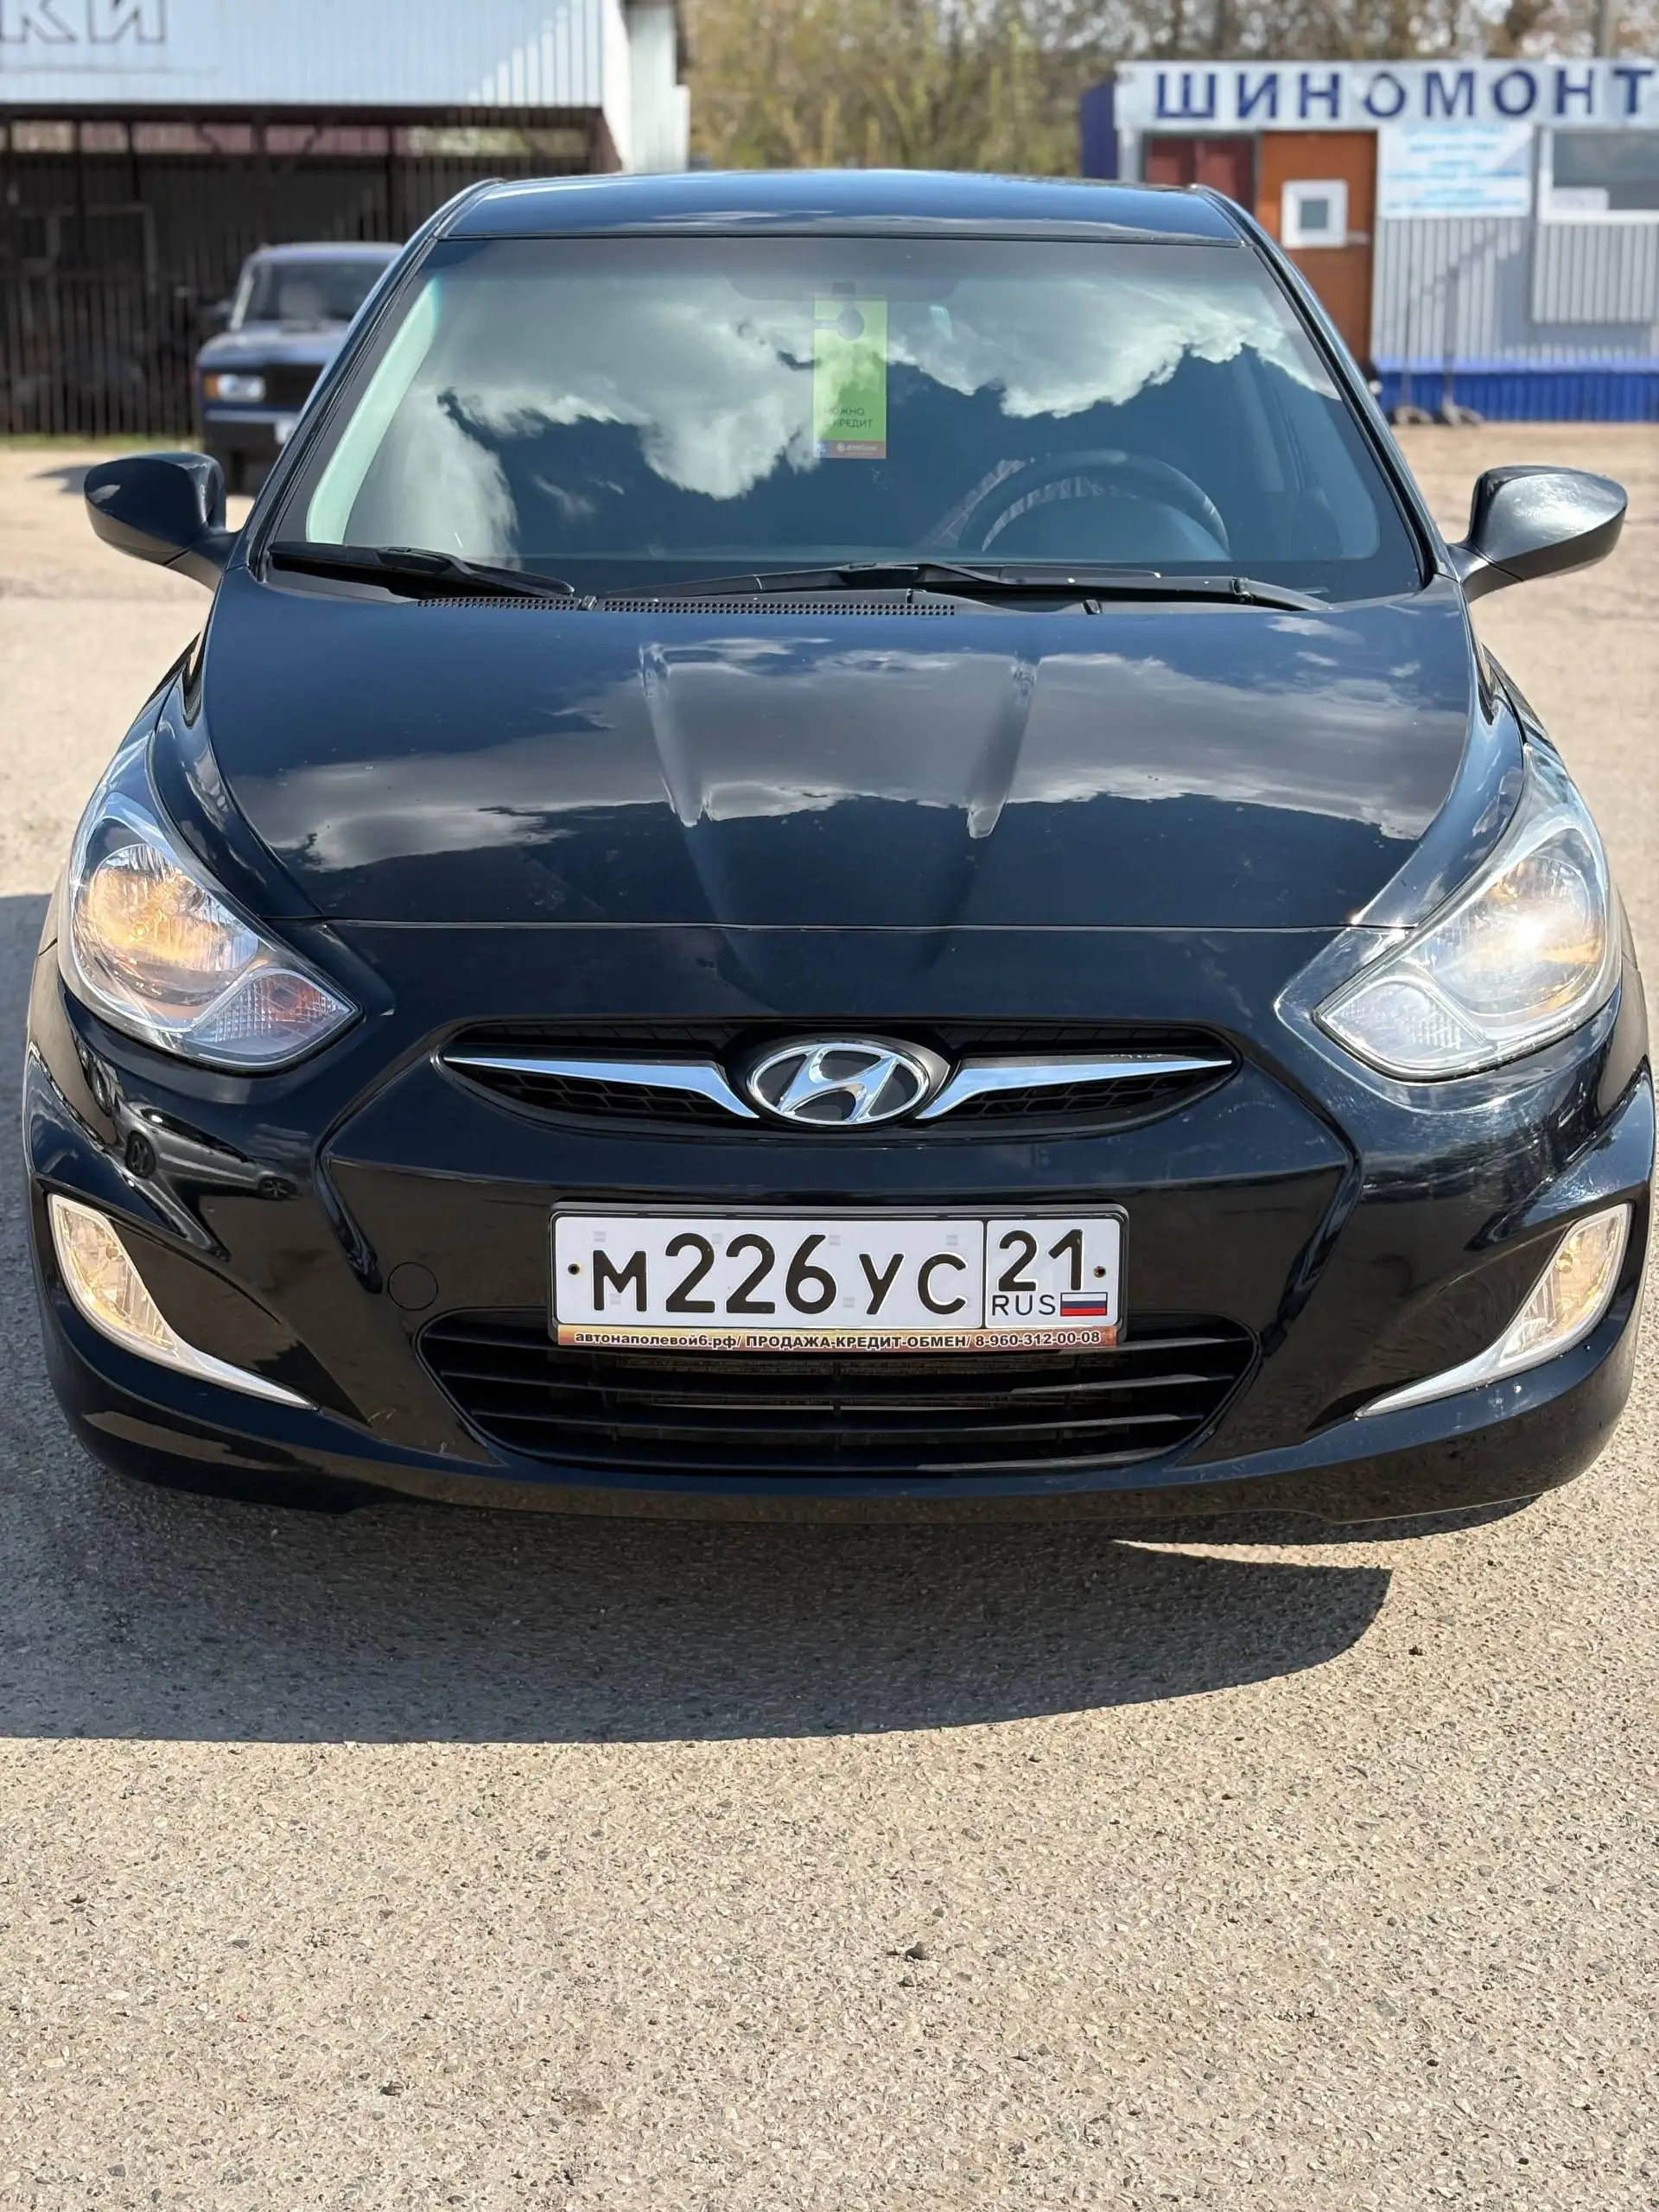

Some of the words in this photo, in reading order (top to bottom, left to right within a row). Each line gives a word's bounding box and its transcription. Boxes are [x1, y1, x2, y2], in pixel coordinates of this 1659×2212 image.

[1156, 68, 1653, 118] ШИНОМОНТ
[592, 1231, 968, 1316] М226УС
[997, 1228, 1084, 1293] 21
[991, 1294, 1056, 1317] RUS
[975, 1332, 1101, 1347] 8-960-312-00-08
